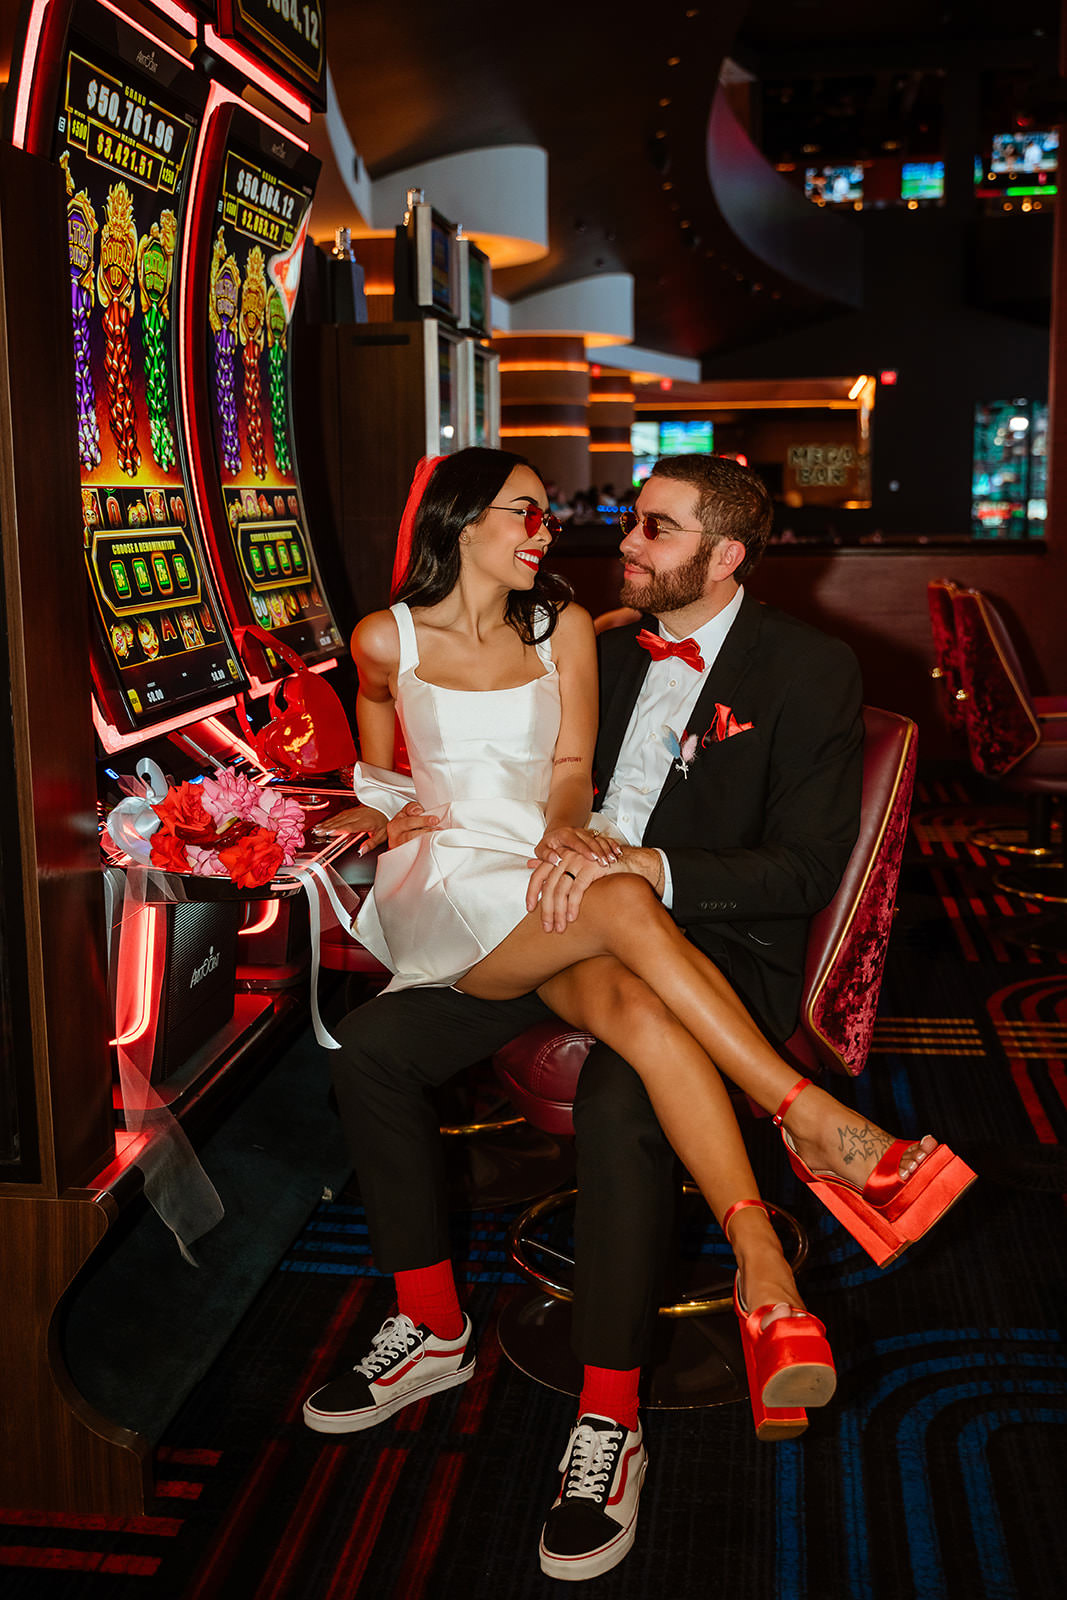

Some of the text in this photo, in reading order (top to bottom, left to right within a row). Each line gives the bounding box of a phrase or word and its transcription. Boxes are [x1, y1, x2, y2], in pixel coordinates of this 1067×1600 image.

[124, 85, 147, 106] GRAND
[71, 119, 88, 141] $500
[86, 79, 174, 154] $50,761.96
[96, 132, 154, 180] $3,421.51
[236, 168, 295, 220] $50,864.12
[68, 219, 92, 258] LTRA
[68, 244, 89, 271] PINS
[102, 241, 133, 276] DOUBLE
[110, 265, 122, 287] UP
